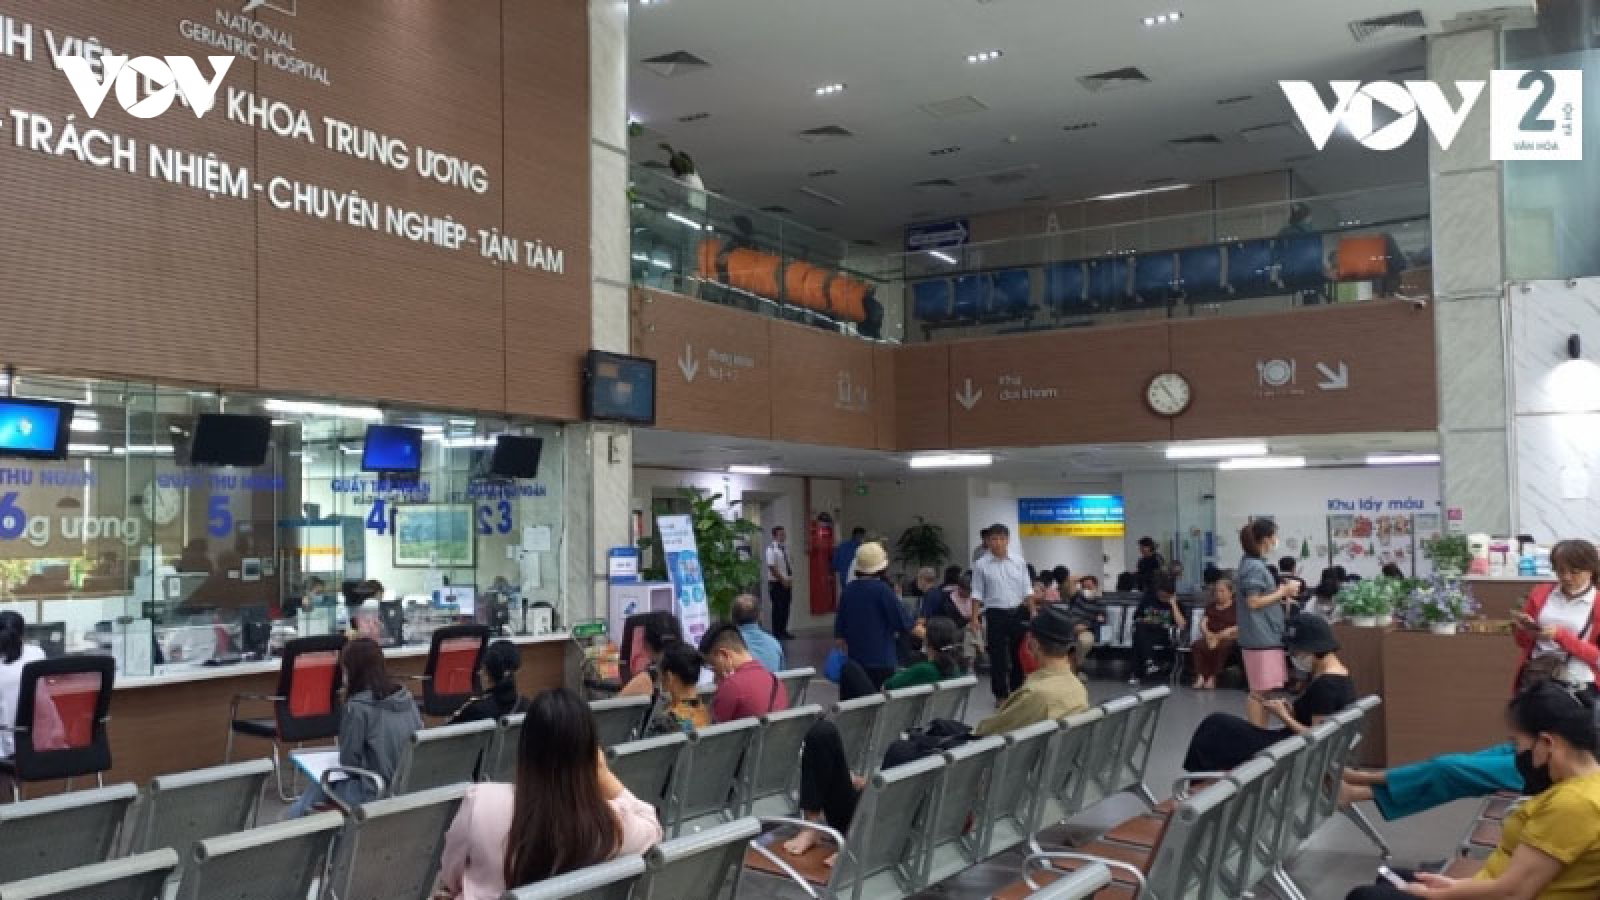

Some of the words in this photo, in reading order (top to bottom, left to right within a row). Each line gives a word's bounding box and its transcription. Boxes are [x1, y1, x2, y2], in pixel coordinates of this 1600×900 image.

[216, 8, 296, 50] NATIONAL
[180, 20, 258, 61] GERIATRIC
[263, 48, 330, 86] HOSPITAL
[10, 108, 137, 172] TRÁCH
[227, 86, 315, 143] KHOA
[323, 116, 409, 170] TRUNG
[0, 491, 27, 541] 6
[207, 495, 234, 538] 5
[366, 499, 388, 536] 4
[497, 500, 514, 535] 3
[1327, 498, 1355, 511] Khu
